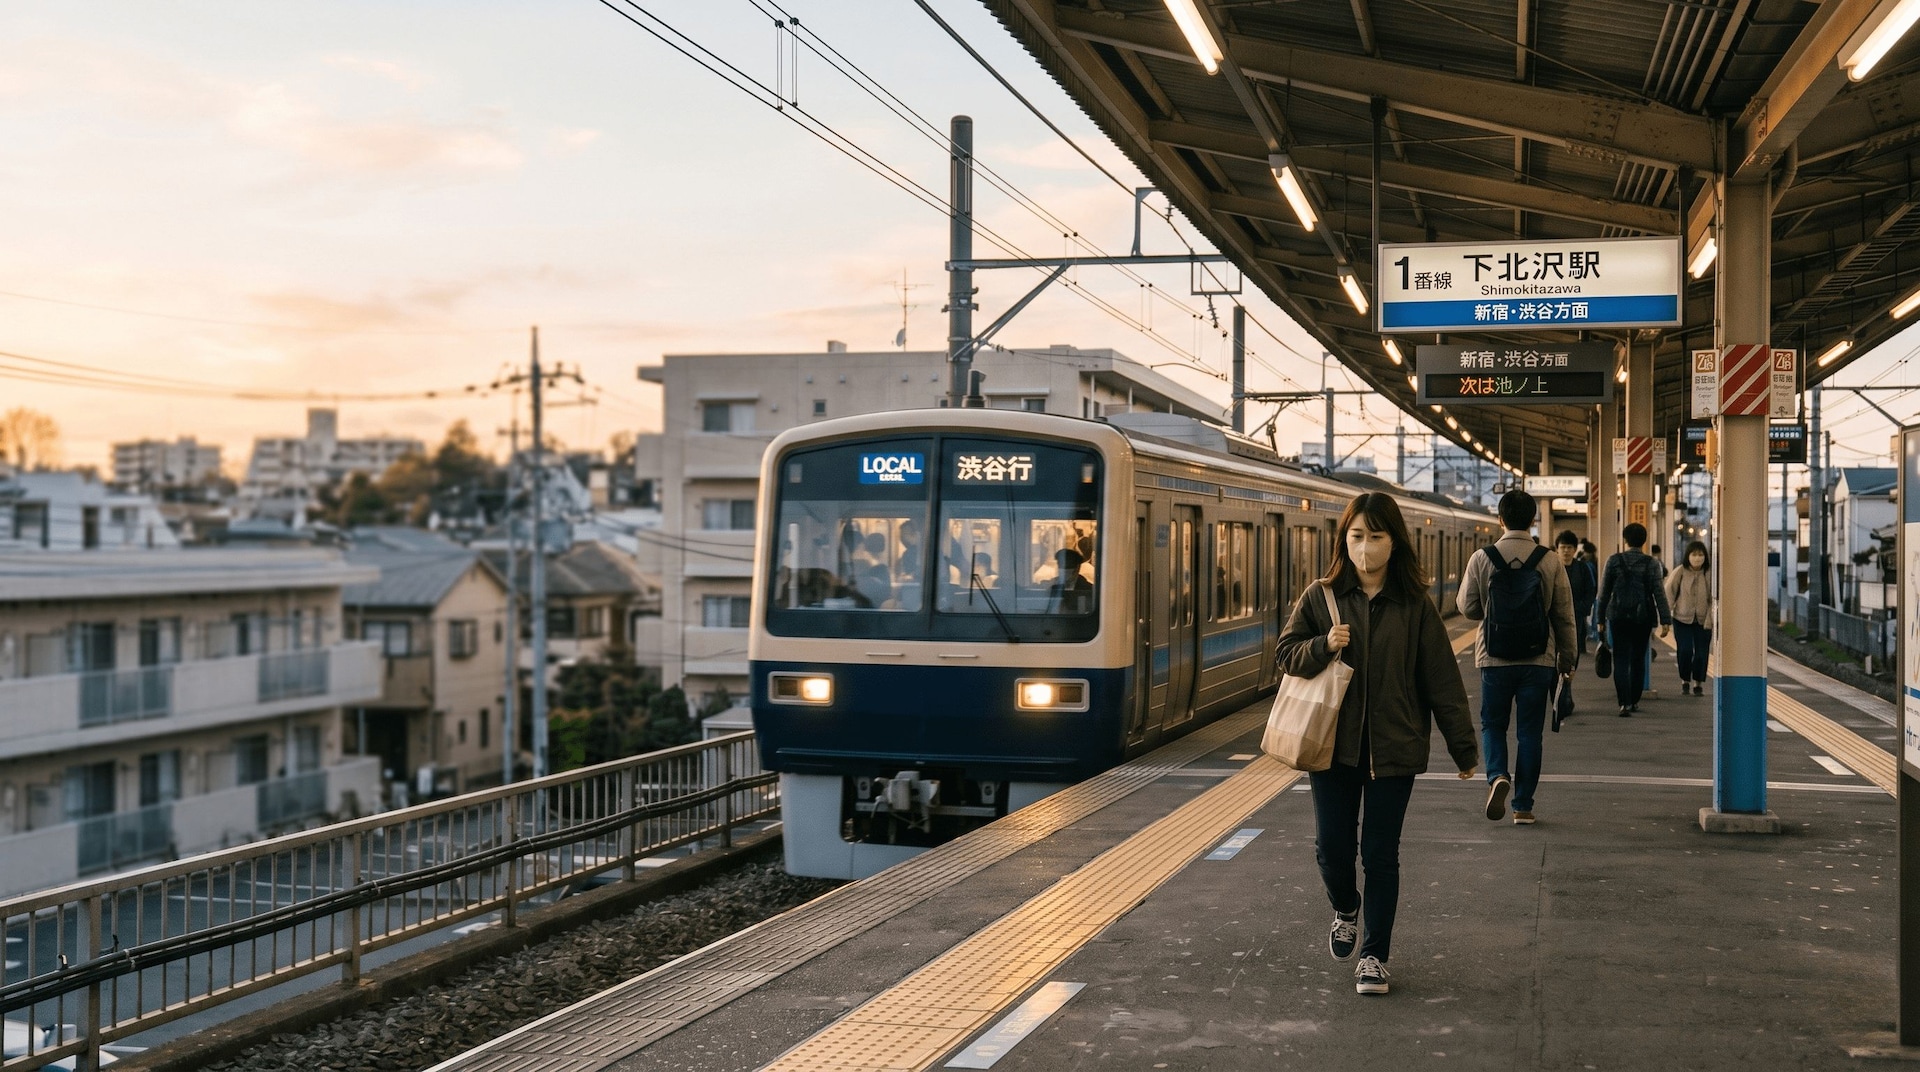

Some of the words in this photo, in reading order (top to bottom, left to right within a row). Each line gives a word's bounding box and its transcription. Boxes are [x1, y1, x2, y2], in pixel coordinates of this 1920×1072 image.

[1463, 251, 1600, 282] 下北沢駅
[1481, 284, 1581, 296] Shimokitazawa
[1474, 302, 1588, 321] 新宿・渋谷方面
[1460, 350, 1569, 368] 新宿・渋谷方面
[1460, 376, 1548, 394] 次は池ノ上
[863, 456, 922, 474] LOCAL
[957, 456, 1033, 481] 渋谷行
